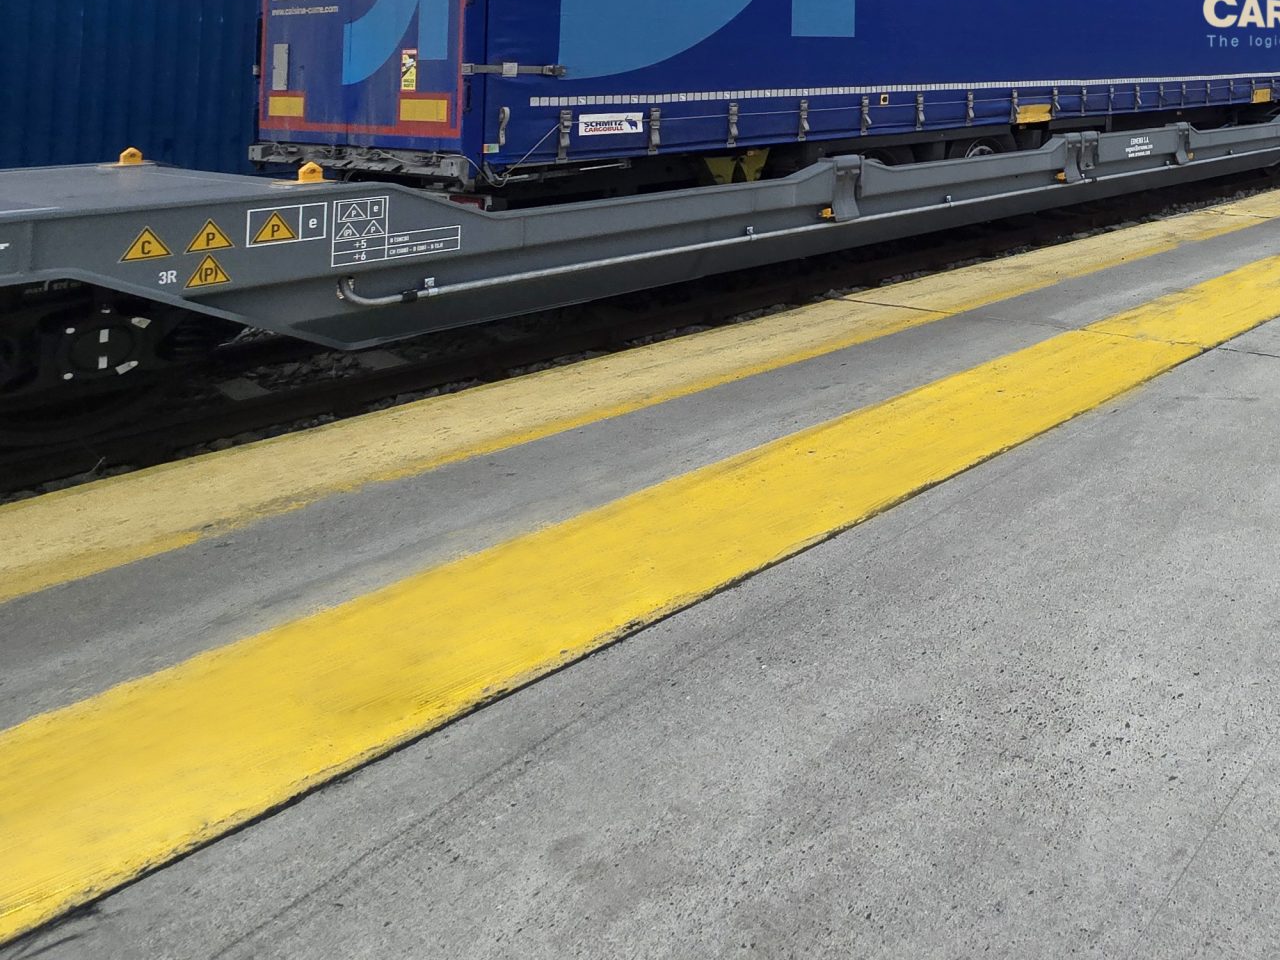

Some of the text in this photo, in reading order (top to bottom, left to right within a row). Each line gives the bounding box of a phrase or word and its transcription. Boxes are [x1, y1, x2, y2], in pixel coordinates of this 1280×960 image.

[1206, 35, 1240, 47] The
[584, 120, 623, 128] SCHMITZ
[271, 218, 318, 237] P e
[206, 232, 215, 246] P
[353, 240, 367, 248] +5
[141, 240, 152, 255] C
[353, 252, 367, 260] +6
[158, 271, 177, 285] 3R
[199, 267, 218, 282] (P)
